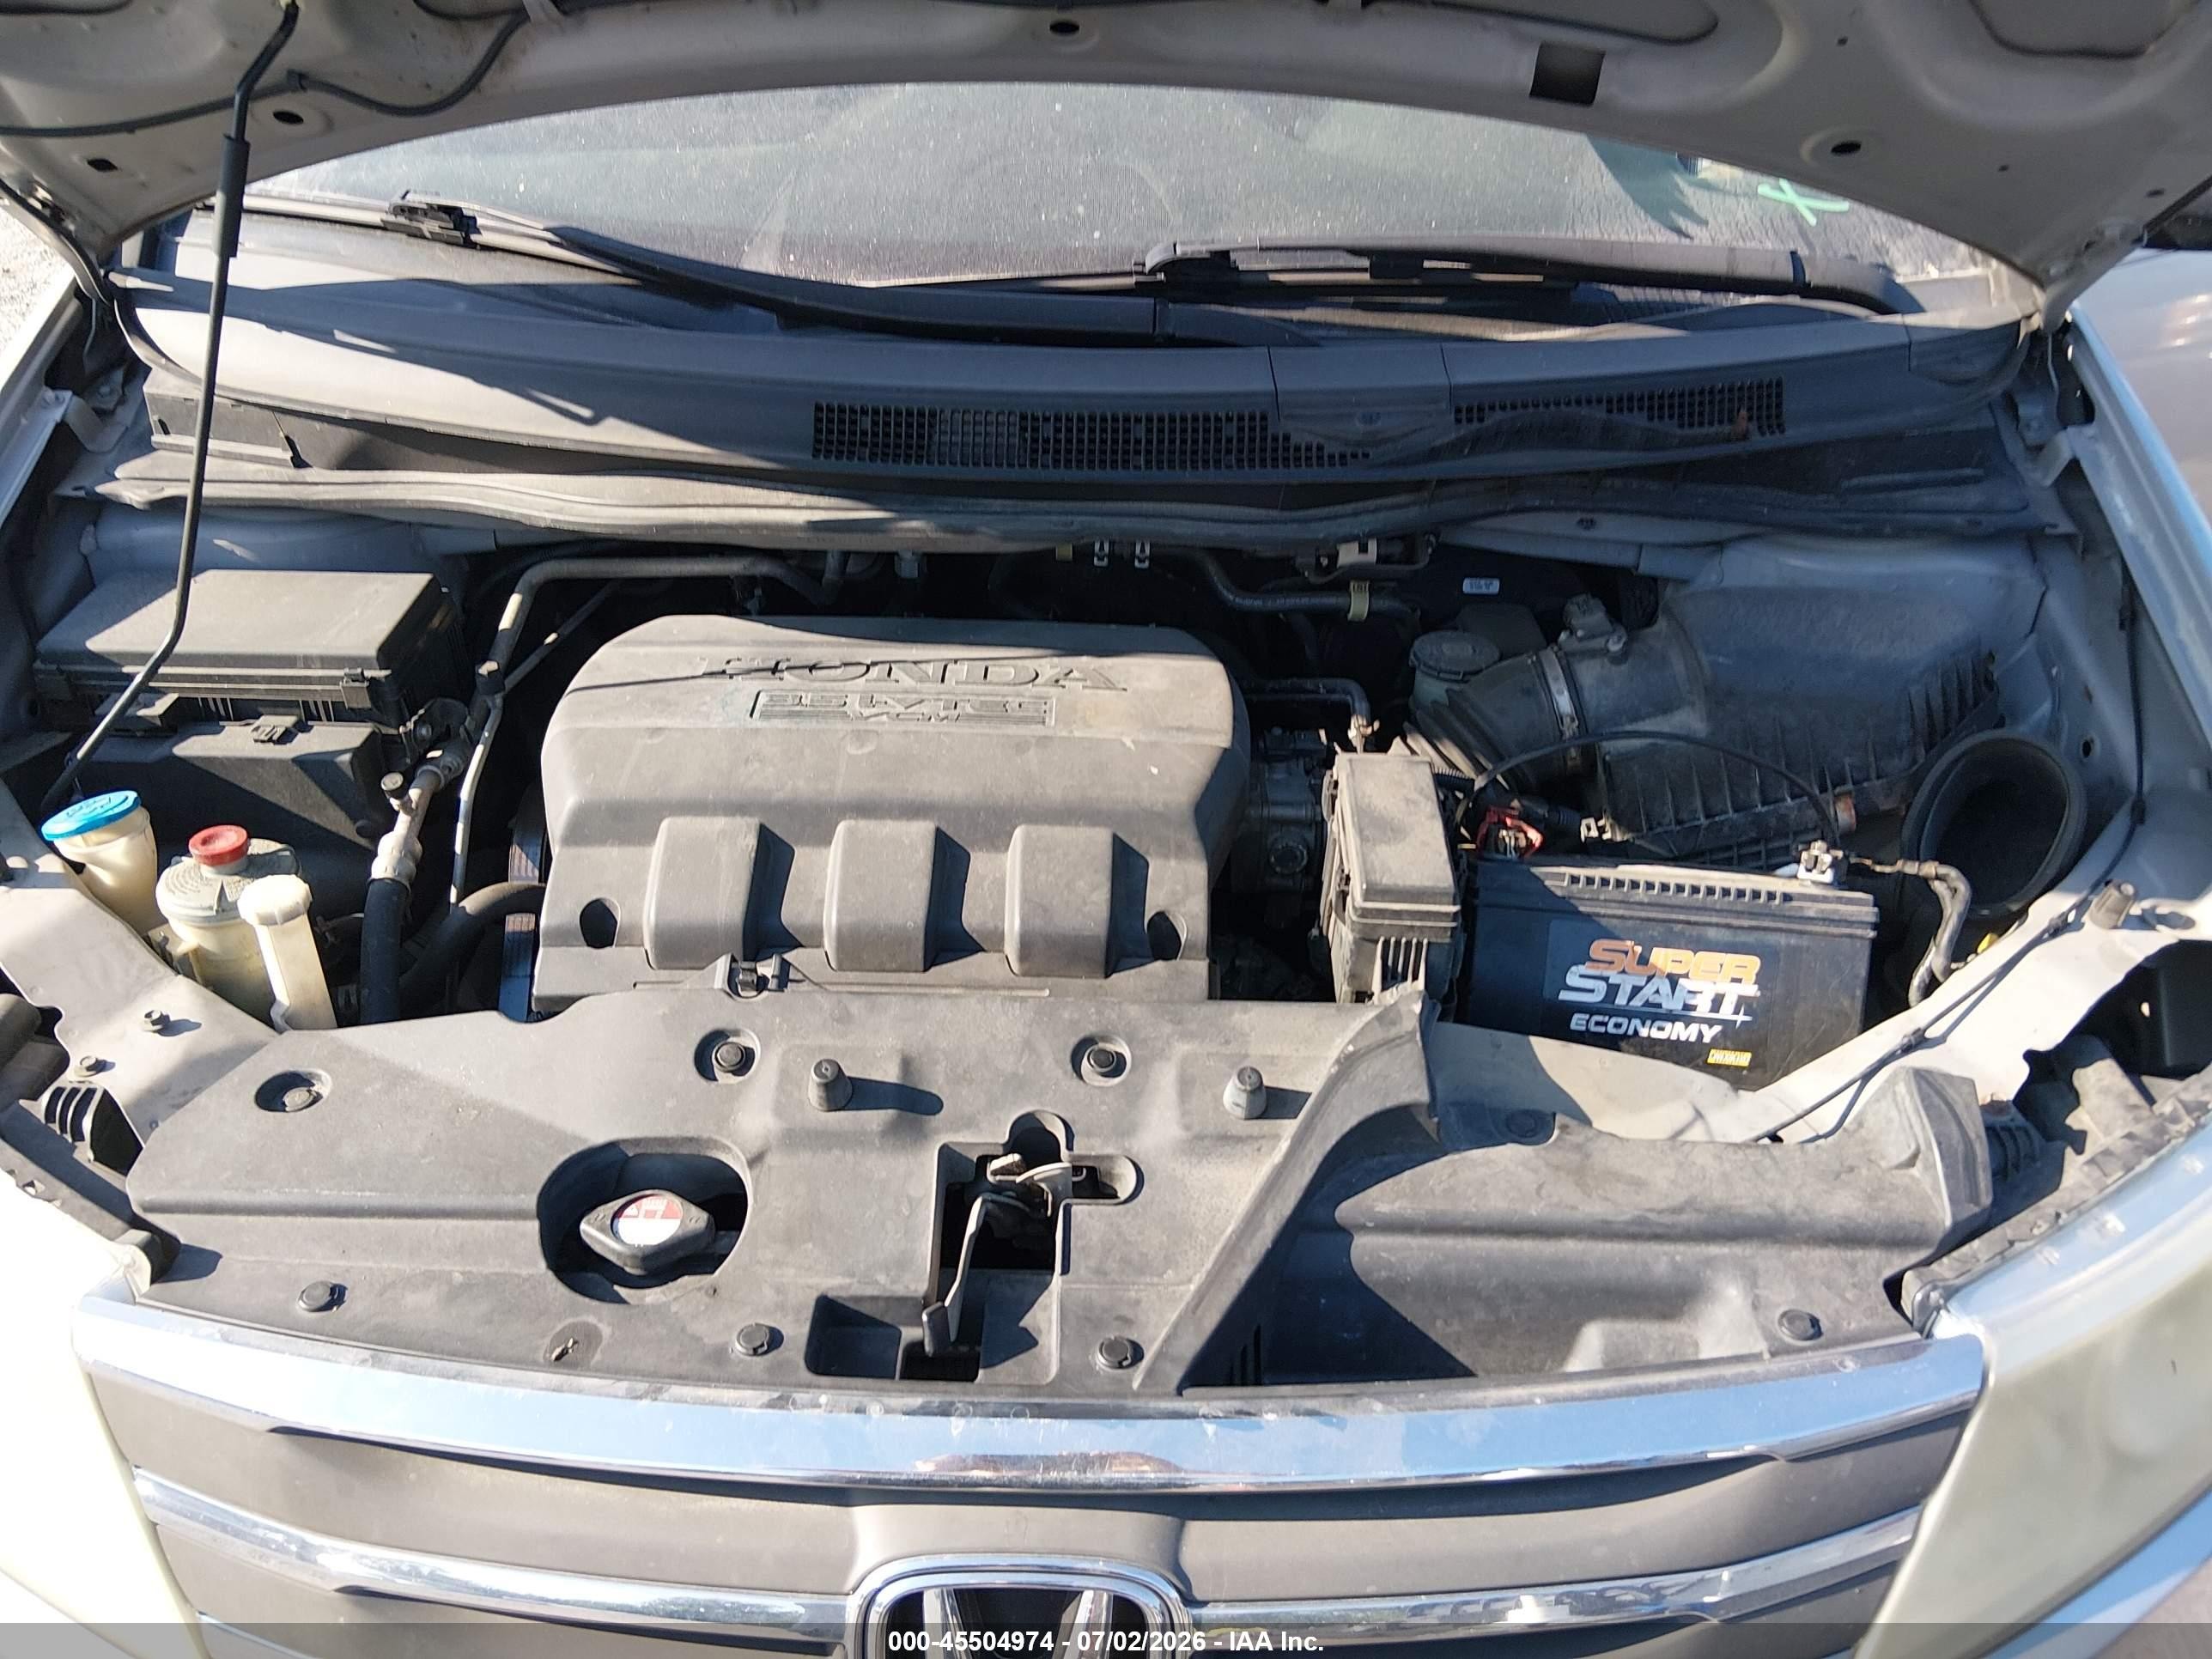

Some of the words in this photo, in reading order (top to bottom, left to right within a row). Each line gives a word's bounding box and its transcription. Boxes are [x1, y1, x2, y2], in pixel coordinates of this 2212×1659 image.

[698, 657, 1127, 691] HONDA
[1585, 939, 1760, 986] SUPER
[1559, 964, 1761, 1016] START
[1570, 1012, 1723, 1043] ECONOMY
